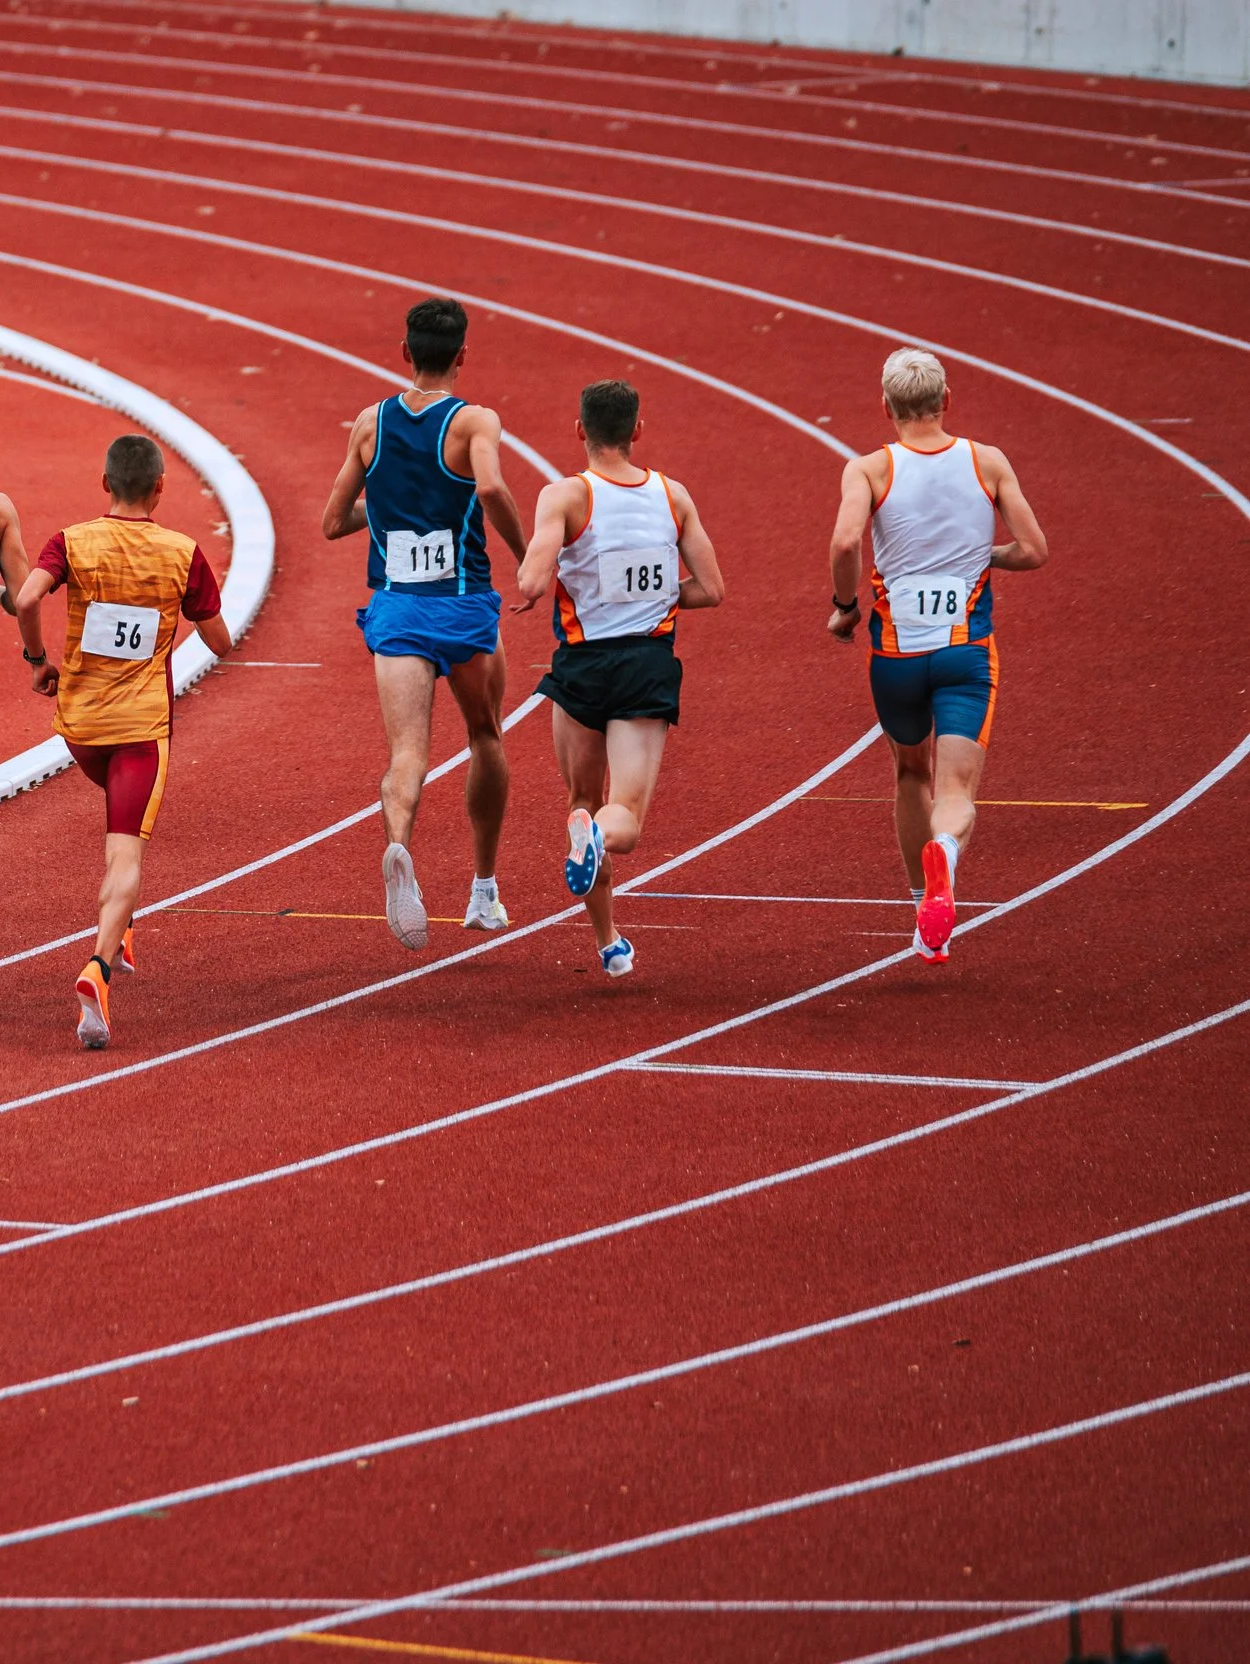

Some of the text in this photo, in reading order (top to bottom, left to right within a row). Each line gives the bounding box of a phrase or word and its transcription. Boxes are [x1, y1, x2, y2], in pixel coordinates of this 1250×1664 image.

[410, 544, 446, 571] 114
[625, 563, 663, 592] 185
[917, 590, 957, 615] 178
[114, 621, 142, 649] 56
